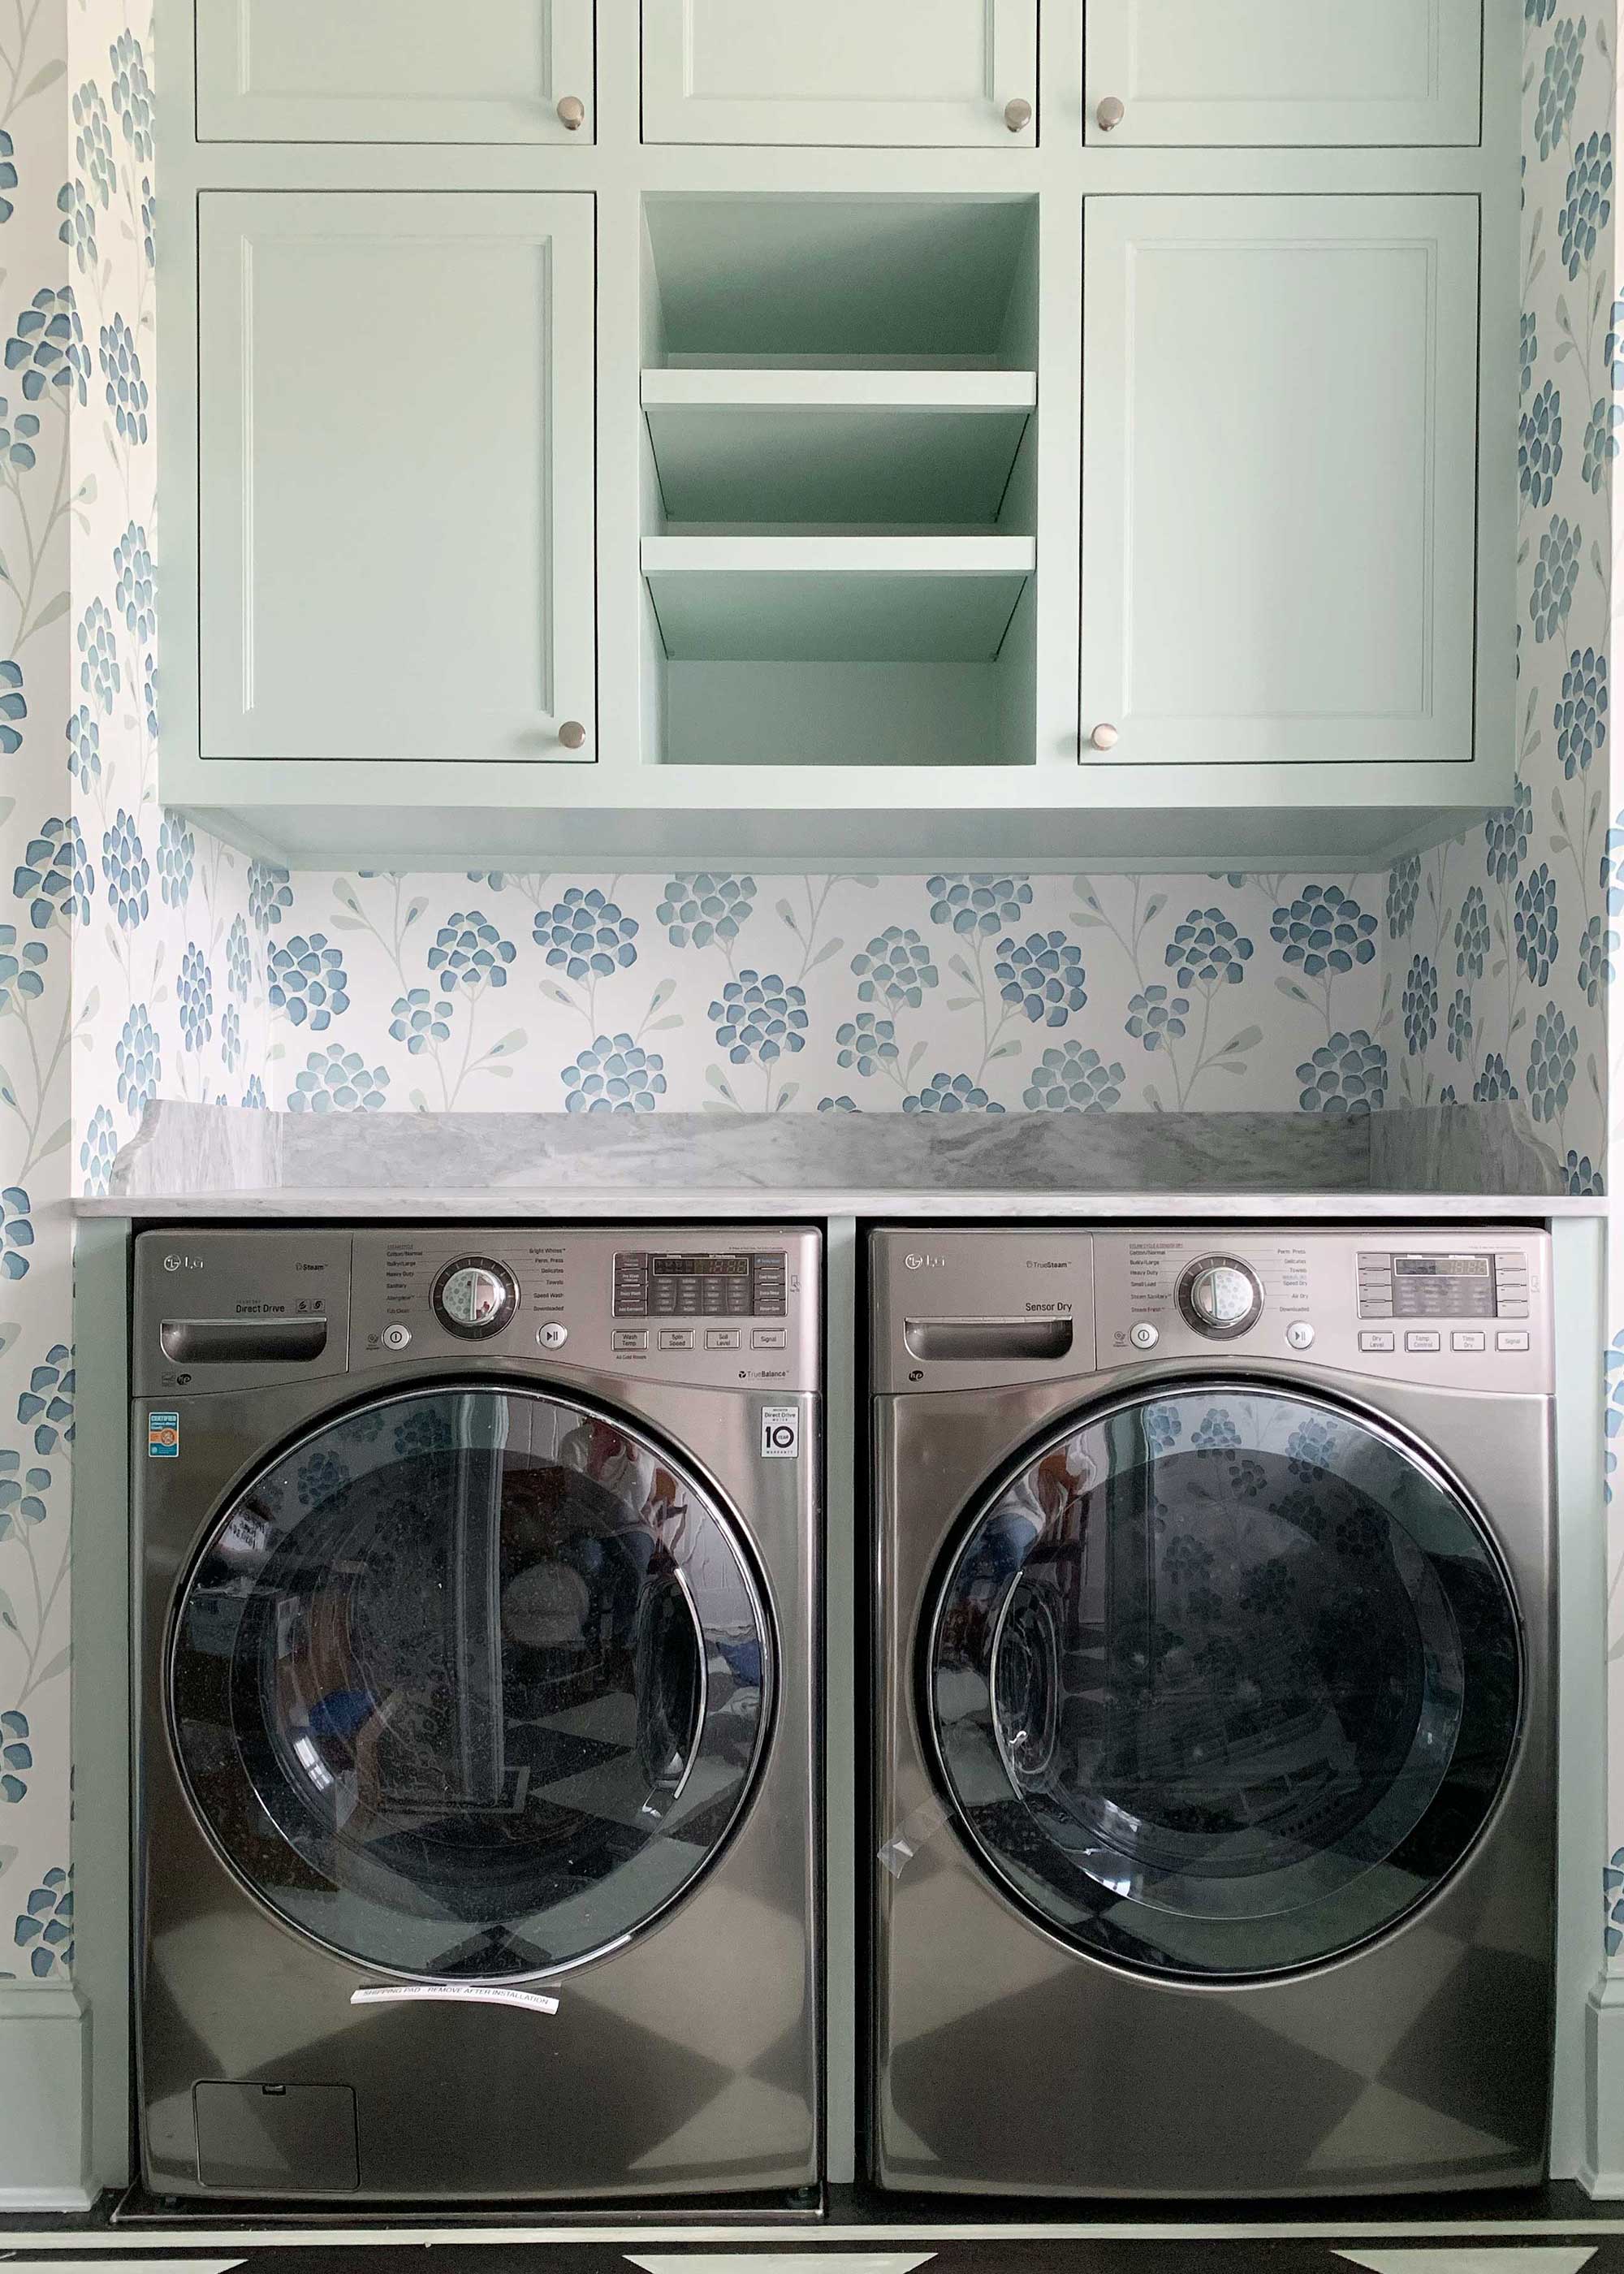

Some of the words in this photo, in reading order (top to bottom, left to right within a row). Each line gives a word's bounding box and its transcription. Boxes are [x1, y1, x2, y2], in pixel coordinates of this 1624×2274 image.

[236, 1304, 261, 1313] Direct
[263, 1304, 285, 1312] Drive
[1026, 1302, 1055, 1312] Sensor
[1057, 1302, 1073, 1312] Dry
[765, 1425, 795, 1449] 10
[364, 1987, 403, 1996] SHIPPING
[464, 1987, 491, 1995] AFTER
[492, 1989, 549, 2005] INSTALLATION
